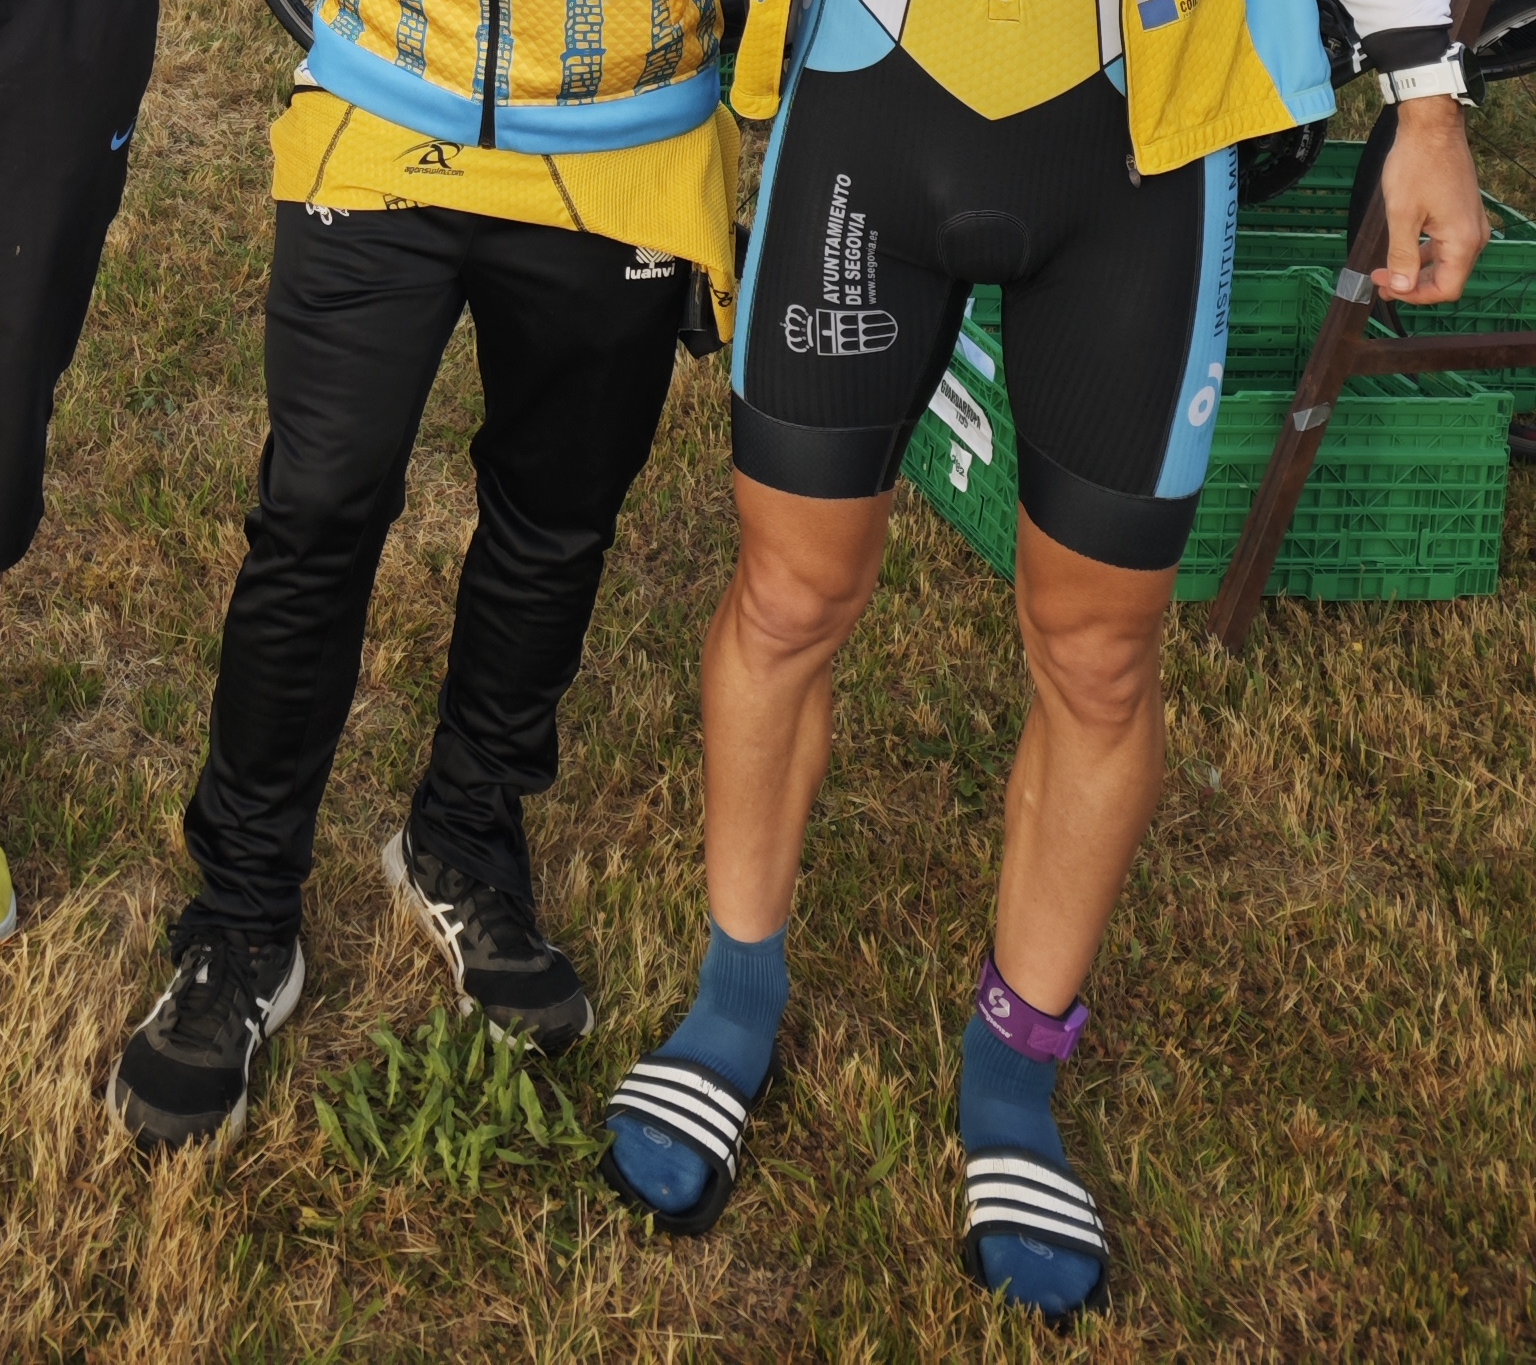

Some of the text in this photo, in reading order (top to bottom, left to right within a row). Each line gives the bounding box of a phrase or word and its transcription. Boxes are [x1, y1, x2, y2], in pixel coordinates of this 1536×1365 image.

[404, 166, 465, 177] agonswim.com
[625, 263, 676, 280] luanvi
[823, 173, 852, 305] AYUNTAMIENTO
[844, 212, 867, 306] DE SEGOVIA
[866, 230, 879, 305] www.segovia.es
[1214, 199, 1237, 338] INSTITUTO
